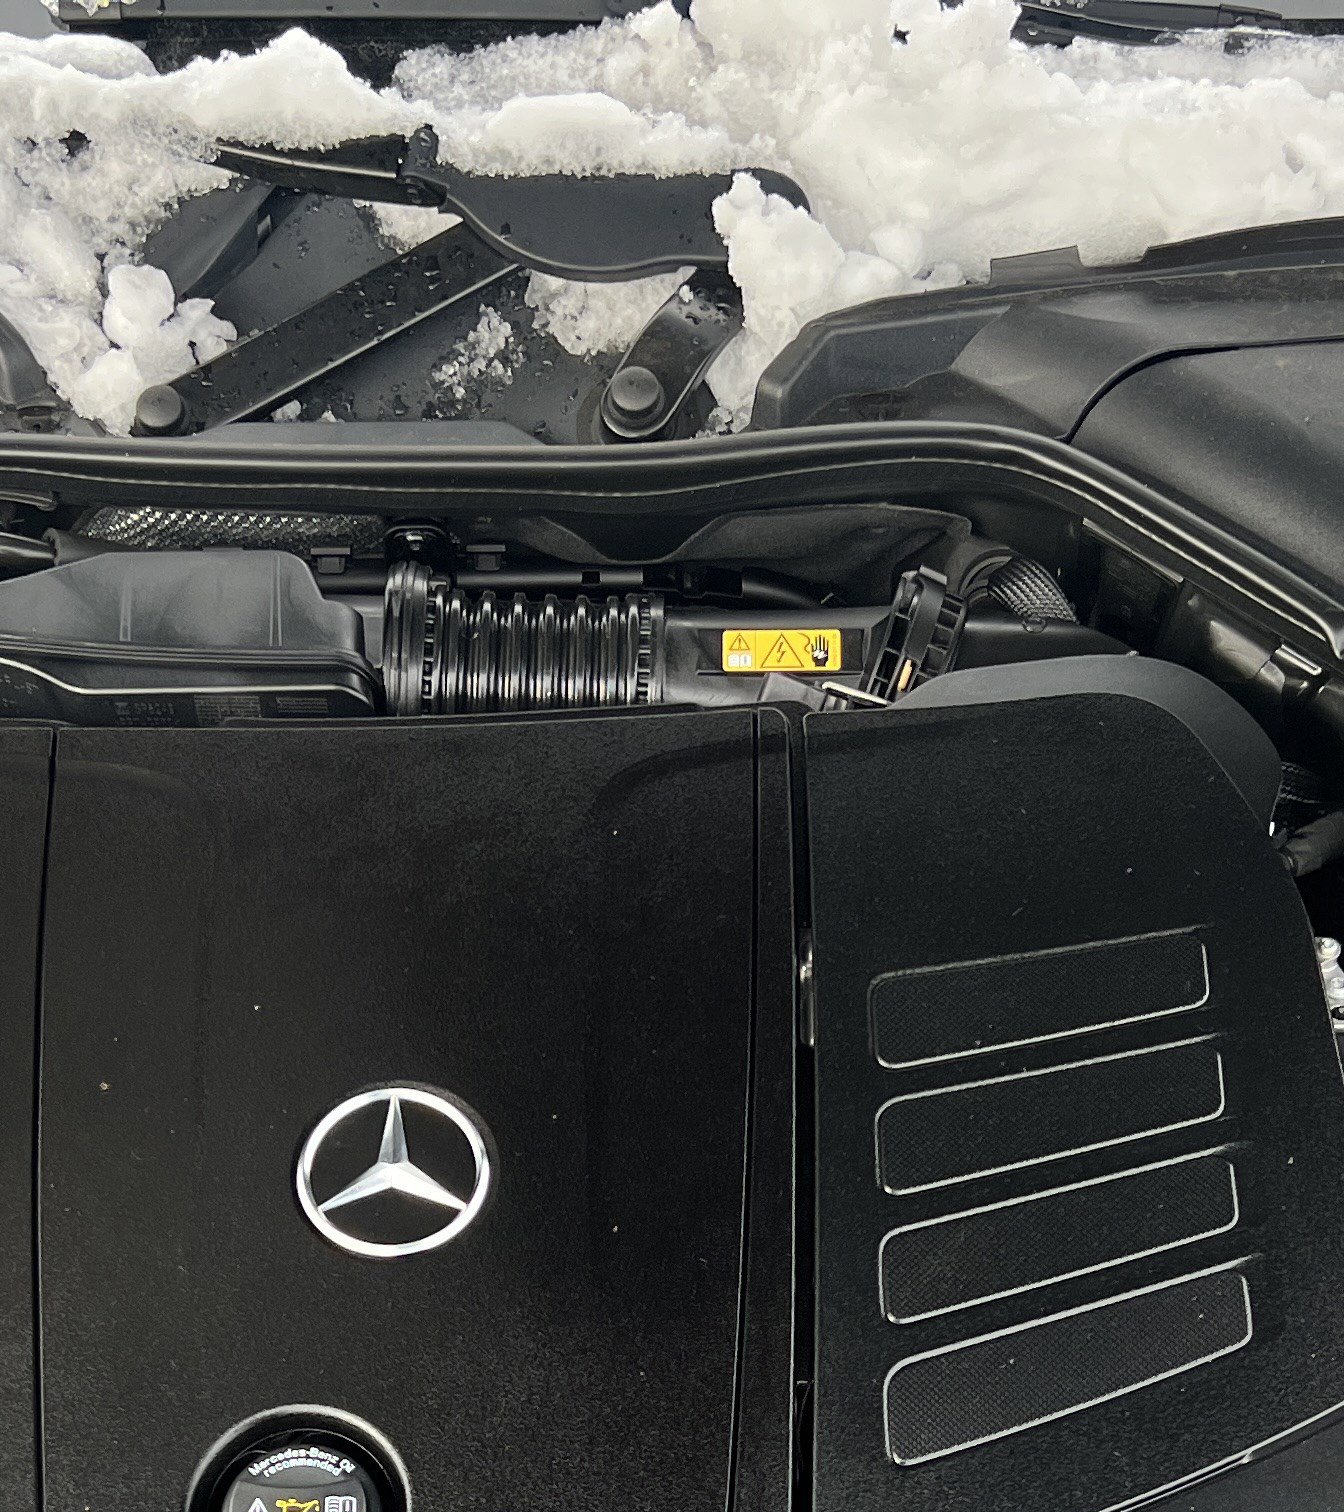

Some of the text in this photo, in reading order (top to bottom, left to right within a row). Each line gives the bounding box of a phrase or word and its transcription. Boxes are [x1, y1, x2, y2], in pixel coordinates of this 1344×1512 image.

[247, 1446, 356, 1476] Mercedes-Benz Oil
[262, 1457, 343, 1478] recommended
